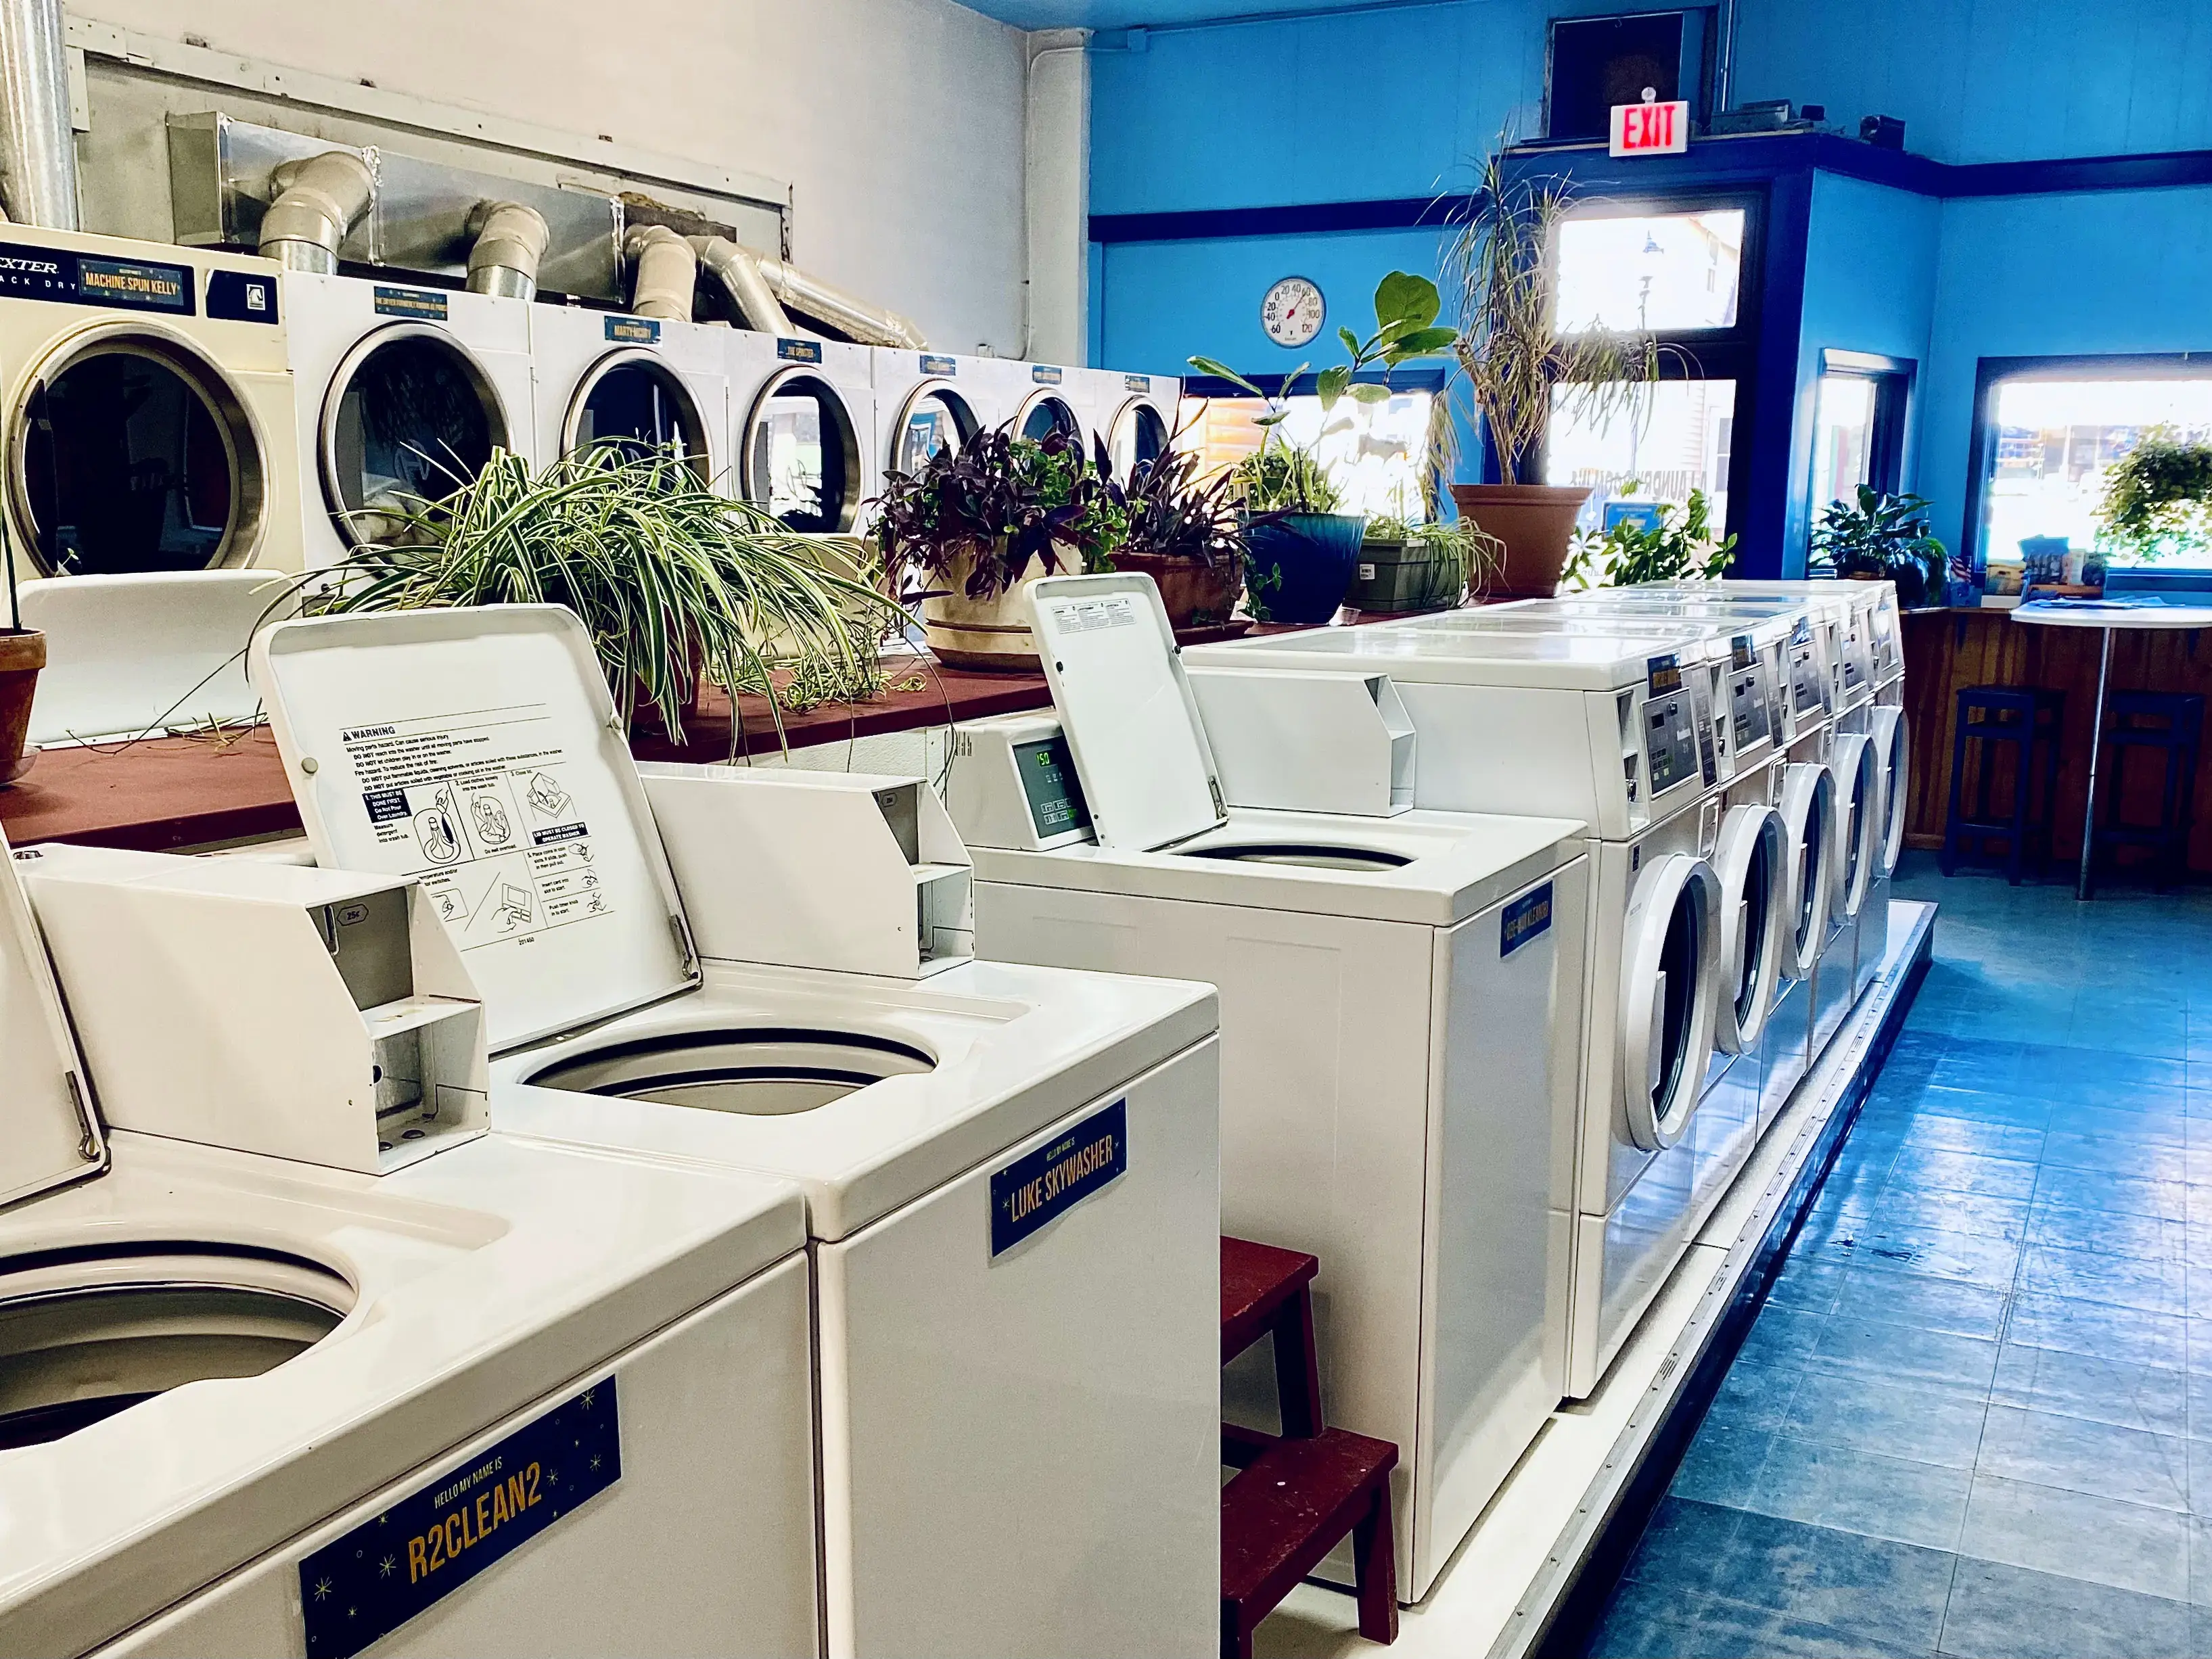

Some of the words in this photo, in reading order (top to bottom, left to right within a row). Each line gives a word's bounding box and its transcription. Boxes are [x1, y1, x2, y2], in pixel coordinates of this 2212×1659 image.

[1623, 106, 1675, 148] EXIT
[0, 257, 57, 274] XTER
[45, 280, 75, 289] DRY
[86, 273, 126, 289] MACHINE
[128, 277, 149, 292] SPUN
[152, 280, 177, 296] KELLY
[1292, 284, 1301, 293] 40
[1281, 285, 1289, 295] 20
[1302, 287, 1310, 296] 60
[1275, 292, 1279, 300] 0
[1308, 298, 1318, 306] 80
[1308, 310, 1320, 319] 100
[1302, 324, 1312, 333] 120
[351, 726, 395, 739] WARNING
[1012, 1177, 1042, 1223] LUKE
[1046, 1135, 1112, 1201] SKYWASHER
[434, 1484, 459, 1509] HELLO
[460, 1474, 471, 1493] MY
[473, 1461, 494, 1485] NAME
[495, 1456, 502, 1470] IS
[409, 1462, 543, 1584] R2CLEAN2
